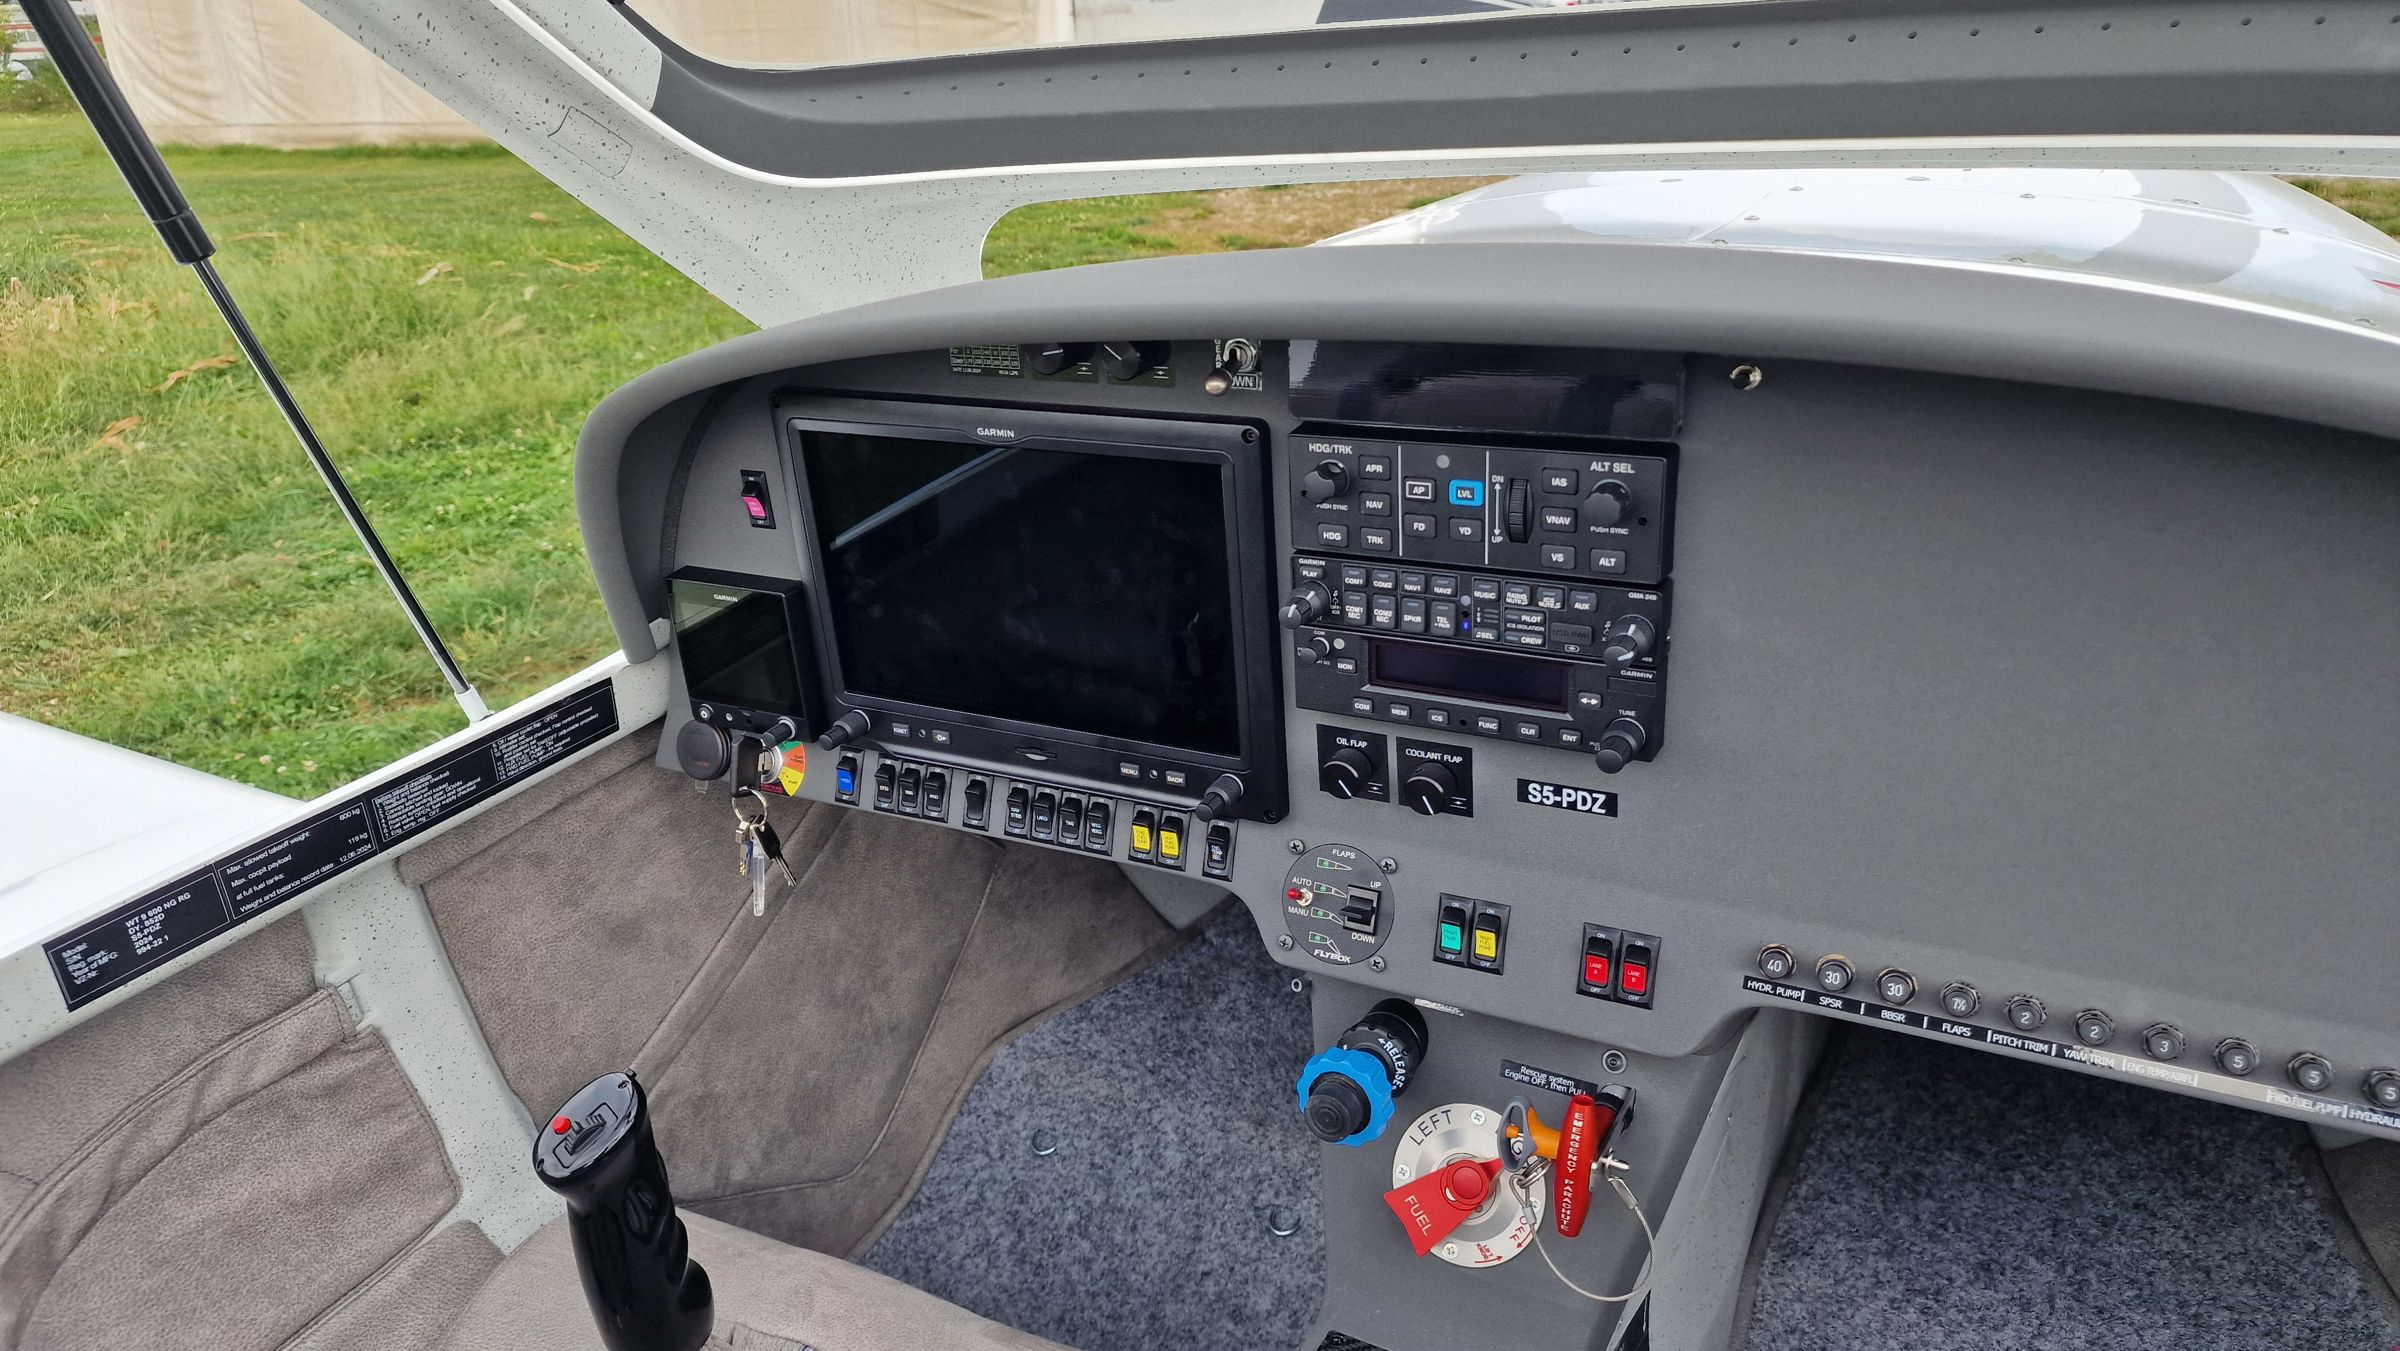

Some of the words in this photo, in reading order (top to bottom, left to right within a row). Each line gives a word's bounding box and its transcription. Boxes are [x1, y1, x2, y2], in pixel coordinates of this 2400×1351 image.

[977, 428, 1014, 438] GARMIN
[1308, 443, 1352, 454] HDG/TRK
[1365, 464, 1383, 473] APR
[1590, 462, 1610, 472] ALT
[1612, 462, 1635, 474] SEL
[1551, 478, 1568, 487] IAS
[1413, 486, 1426, 496] AP
[1458, 490, 1472, 499] LVL
[1366, 500, 1383, 510] NAV
[1546, 515, 1570, 526] VNAV
[1414, 522, 1426, 532] FD
[1459, 526, 1472, 536] YD
[1323, 530, 1341, 540] HDG
[1492, 535, 1503, 544] UP
[1367, 536, 1384, 546] TRK
[1298, 558, 1326, 566] GARMIN
[1551, 553, 1564, 562] VS
[1599, 556, 1616, 566] ALT
[1302, 570, 1318, 578] PLAY
[1345, 577, 1363, 585] COM1
[1374, 580, 1392, 589] COM2
[1404, 584, 1421, 592] NAV1
[1434, 586, 1452, 595] NAV2
[714, 594, 738, 602] GARMIN
[1474, 590, 1496, 600] MUSIC
[1346, 606, 1363, 614] COM1
[1574, 602, 1590, 610] AUX
[1404, 614, 1422, 623] SPKR
[1521, 615, 1542, 623] PILOT
[1521, 636, 1542, 644] CREW
[1620, 670, 1653, 680] GARMIN
[1354, 702, 1370, 710] COM
[1392, 708, 1407, 717] MEM
[1431, 714, 1444, 722] ICS
[1619, 709, 1636, 717] TUNE
[1479, 721, 1498, 730] FUNC
[1521, 727, 1536, 736] CLR
[1336, 736, 1348, 746] OIL
[1350, 738, 1367, 748] FLAP
[1562, 734, 1577, 743] ENT
[1406, 748, 1441, 761] COOLANT
[1444, 753, 1462, 764] FLAP
[1121, 766, 1138, 776] MENU
[1167, 776, 1184, 784] BACK
[1527, 782, 1606, 814] S5-PDZ
[339, 811, 352, 821] 600
[226, 864, 243, 875] Max.
[244, 850, 268, 867] allowed
[268, 841, 289, 855] takeoff
[1332, 848, 1355, 860] FLAPS
[231, 877, 248, 888] Max.
[248, 865, 268, 880] cocpit
[267, 854, 292, 871] payload
[243, 888, 253, 897] full
[253, 881, 266, 892] fuel
[265, 872, 285, 885] tanks:
[1292, 876, 1312, 887] AUTO
[1370, 880, 1381, 889] UP
[240, 898, 263, 913] Weight
[263, 891, 276, 901] and
[276, 878, 301, 895] balance
[300, 868, 320, 884] record
[125, 916, 140, 928] WT
[147, 906, 162, 917] 600
[163, 899, 177, 909] NG
[178, 892, 191, 902] RG
[1288, 906, 1309, 917] MANU
[144, 913, 165, 927] 852D
[131, 922, 162, 941] S5-PDZ
[134, 935, 153, 948] 2024
[1351, 932, 1375, 944] DOWN
[136, 938, 163, 955] 994-22
[1313, 949, 1351, 963] FLYBOX
[1767, 960, 1781, 972] 40
[1825, 971, 1840, 985] 30
[1747, 980, 1774, 995] HYDR.
[1776, 986, 1801, 1000] PUMP
[1887, 983, 1903, 996] 30
[1819, 996, 1842, 1009] SPSR
[1881, 1009, 1906, 1023] BBSR
[2020, 1012, 2030, 1024] 2
[1942, 1022, 1971, 1037] FLAPS
[2090, 1026, 2099, 1038] 2
[1992, 1033, 2022, 1048] PITCH
[2023, 1040, 2049, 1054] TRIM
[2159, 1041, 2169, 1052] 3
[2063, 1048, 2089, 1064] YAW
[2089, 1053, 2114, 1068] TRIM
[2233, 1056, 2243, 1068] 5
[1383, 1041, 1406, 1088] RELEASE
[1505, 1068, 1530, 1082] Engine
[1531, 1076, 1548, 1089] OFF,
[1550, 1082, 1567, 1093] then
[1520, 1066, 1547, 1079] Rescue
[1548, 1076, 1574, 1087] system
[2309, 1071, 2320, 1084] 5
[2385, 1087, 2397, 1099] 5
[1409, 1109, 1454, 1146] LEFT
[1567, 1112, 1584, 1173] EMERGENCY
[1561, 1179, 1574, 1232] PARACHUTE
[1404, 1195, 1431, 1236] FUEL
[1509, 1216, 1528, 1241] OFF
